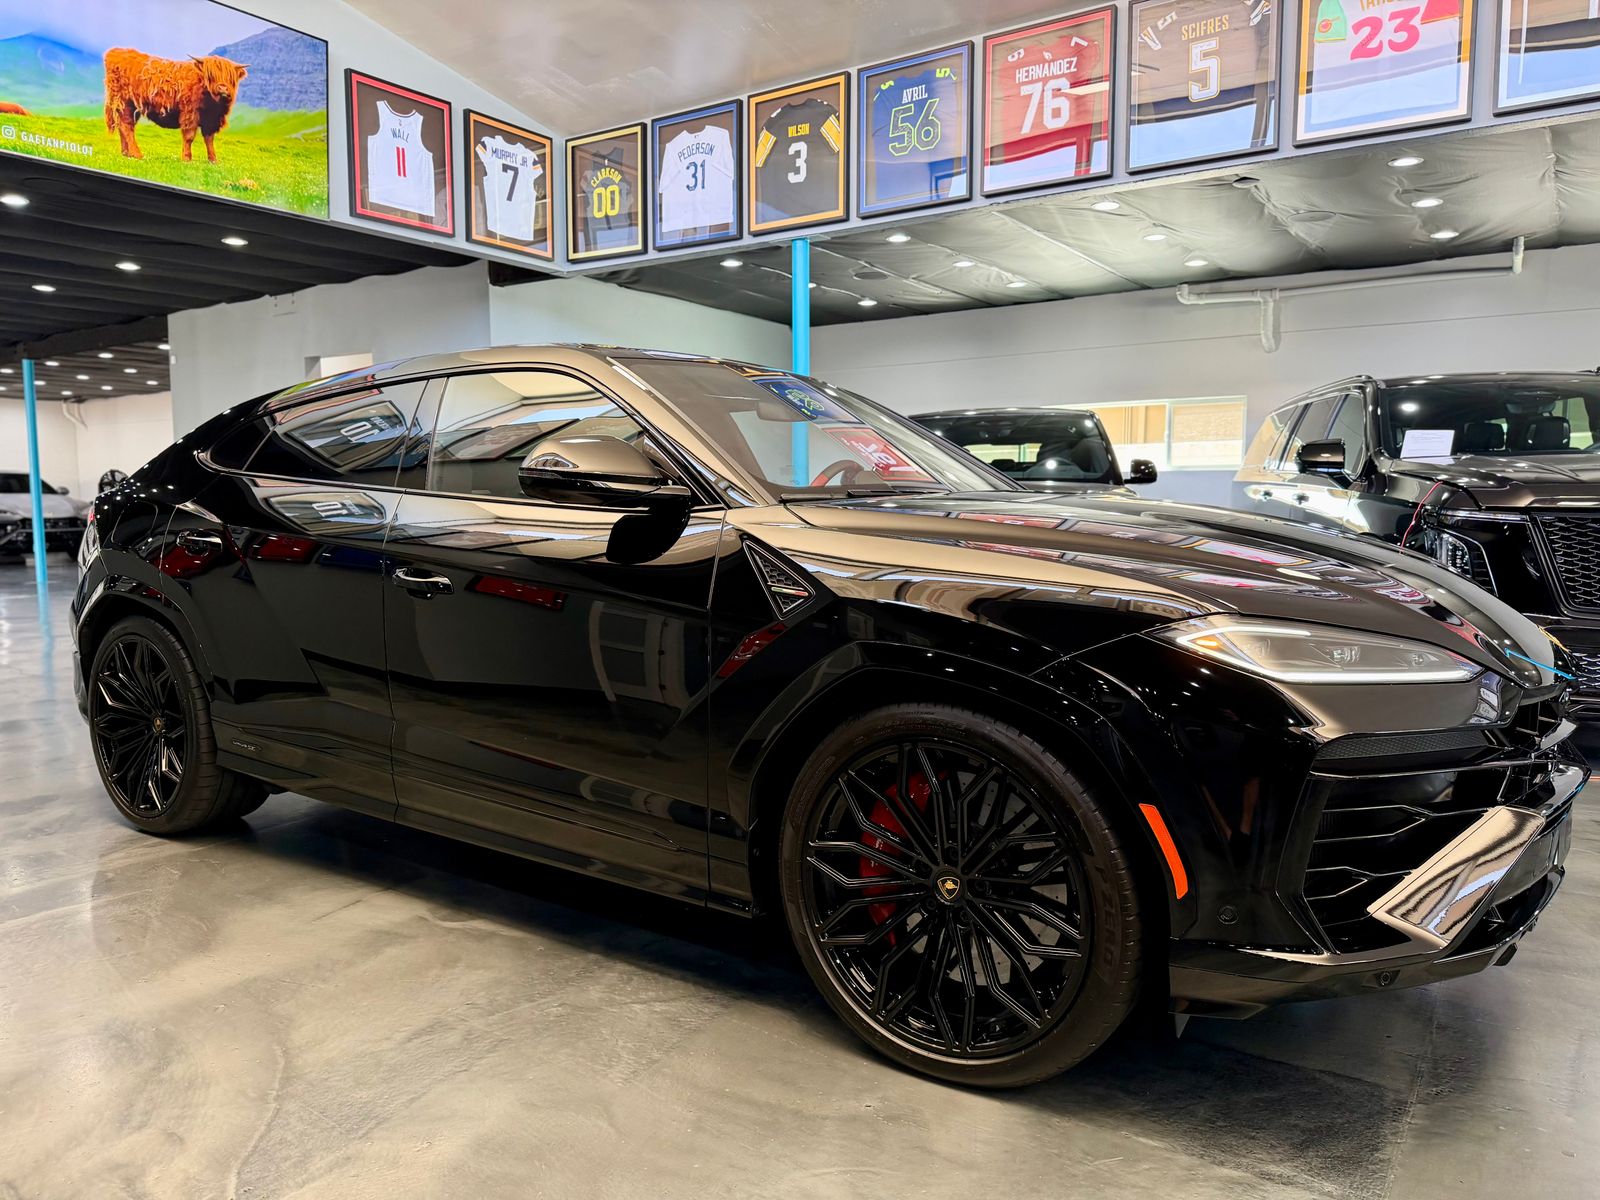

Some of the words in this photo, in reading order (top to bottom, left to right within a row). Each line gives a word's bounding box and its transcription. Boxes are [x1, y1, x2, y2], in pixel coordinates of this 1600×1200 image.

[1181, 14, 1230, 41] SCIFRES
[1350, 6, 1421, 60] 23
[1016, 56, 1078, 84] HERNANDEZ
[1188, 36, 1221, 103] 5
[901, 84, 928, 104] AVRIL
[1020, 77, 1071, 135] 76
[390, 127, 410, 143] WALL
[787, 123, 810, 138] WILSON
[888, 97, 941, 157] 56
[396, 146, 407, 178] 11
[490, 147, 519, 166] MURPHY
[677, 142, 715, 162] PEDERSON
[787, 141, 808, 184] 3
[501, 163, 520, 202] 7
[590, 167, 622, 188] CLARKSON
[686, 159, 706, 192] 31
[593, 184, 620, 219] 00
